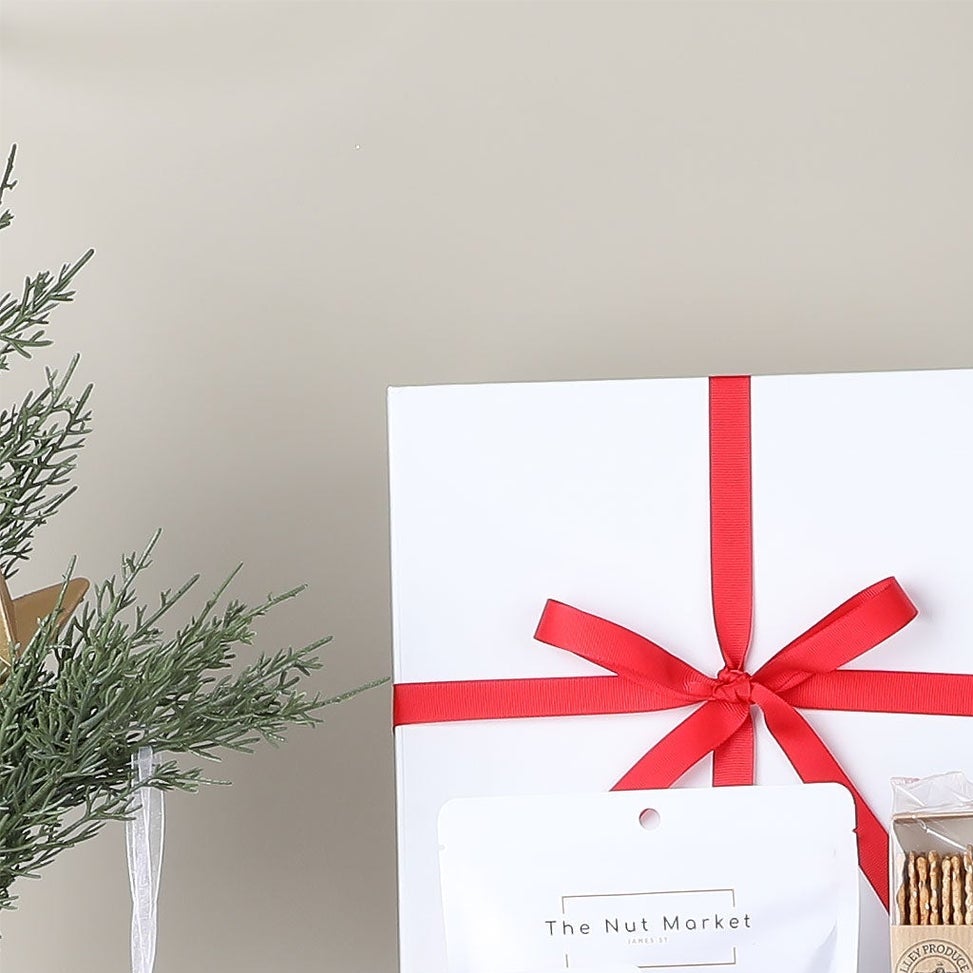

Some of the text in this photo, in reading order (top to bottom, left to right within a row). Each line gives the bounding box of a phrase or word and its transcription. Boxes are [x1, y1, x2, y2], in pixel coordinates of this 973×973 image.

[545, 914, 751, 935] The Nut Market
[922, 944, 969, 973] PRODUCE
